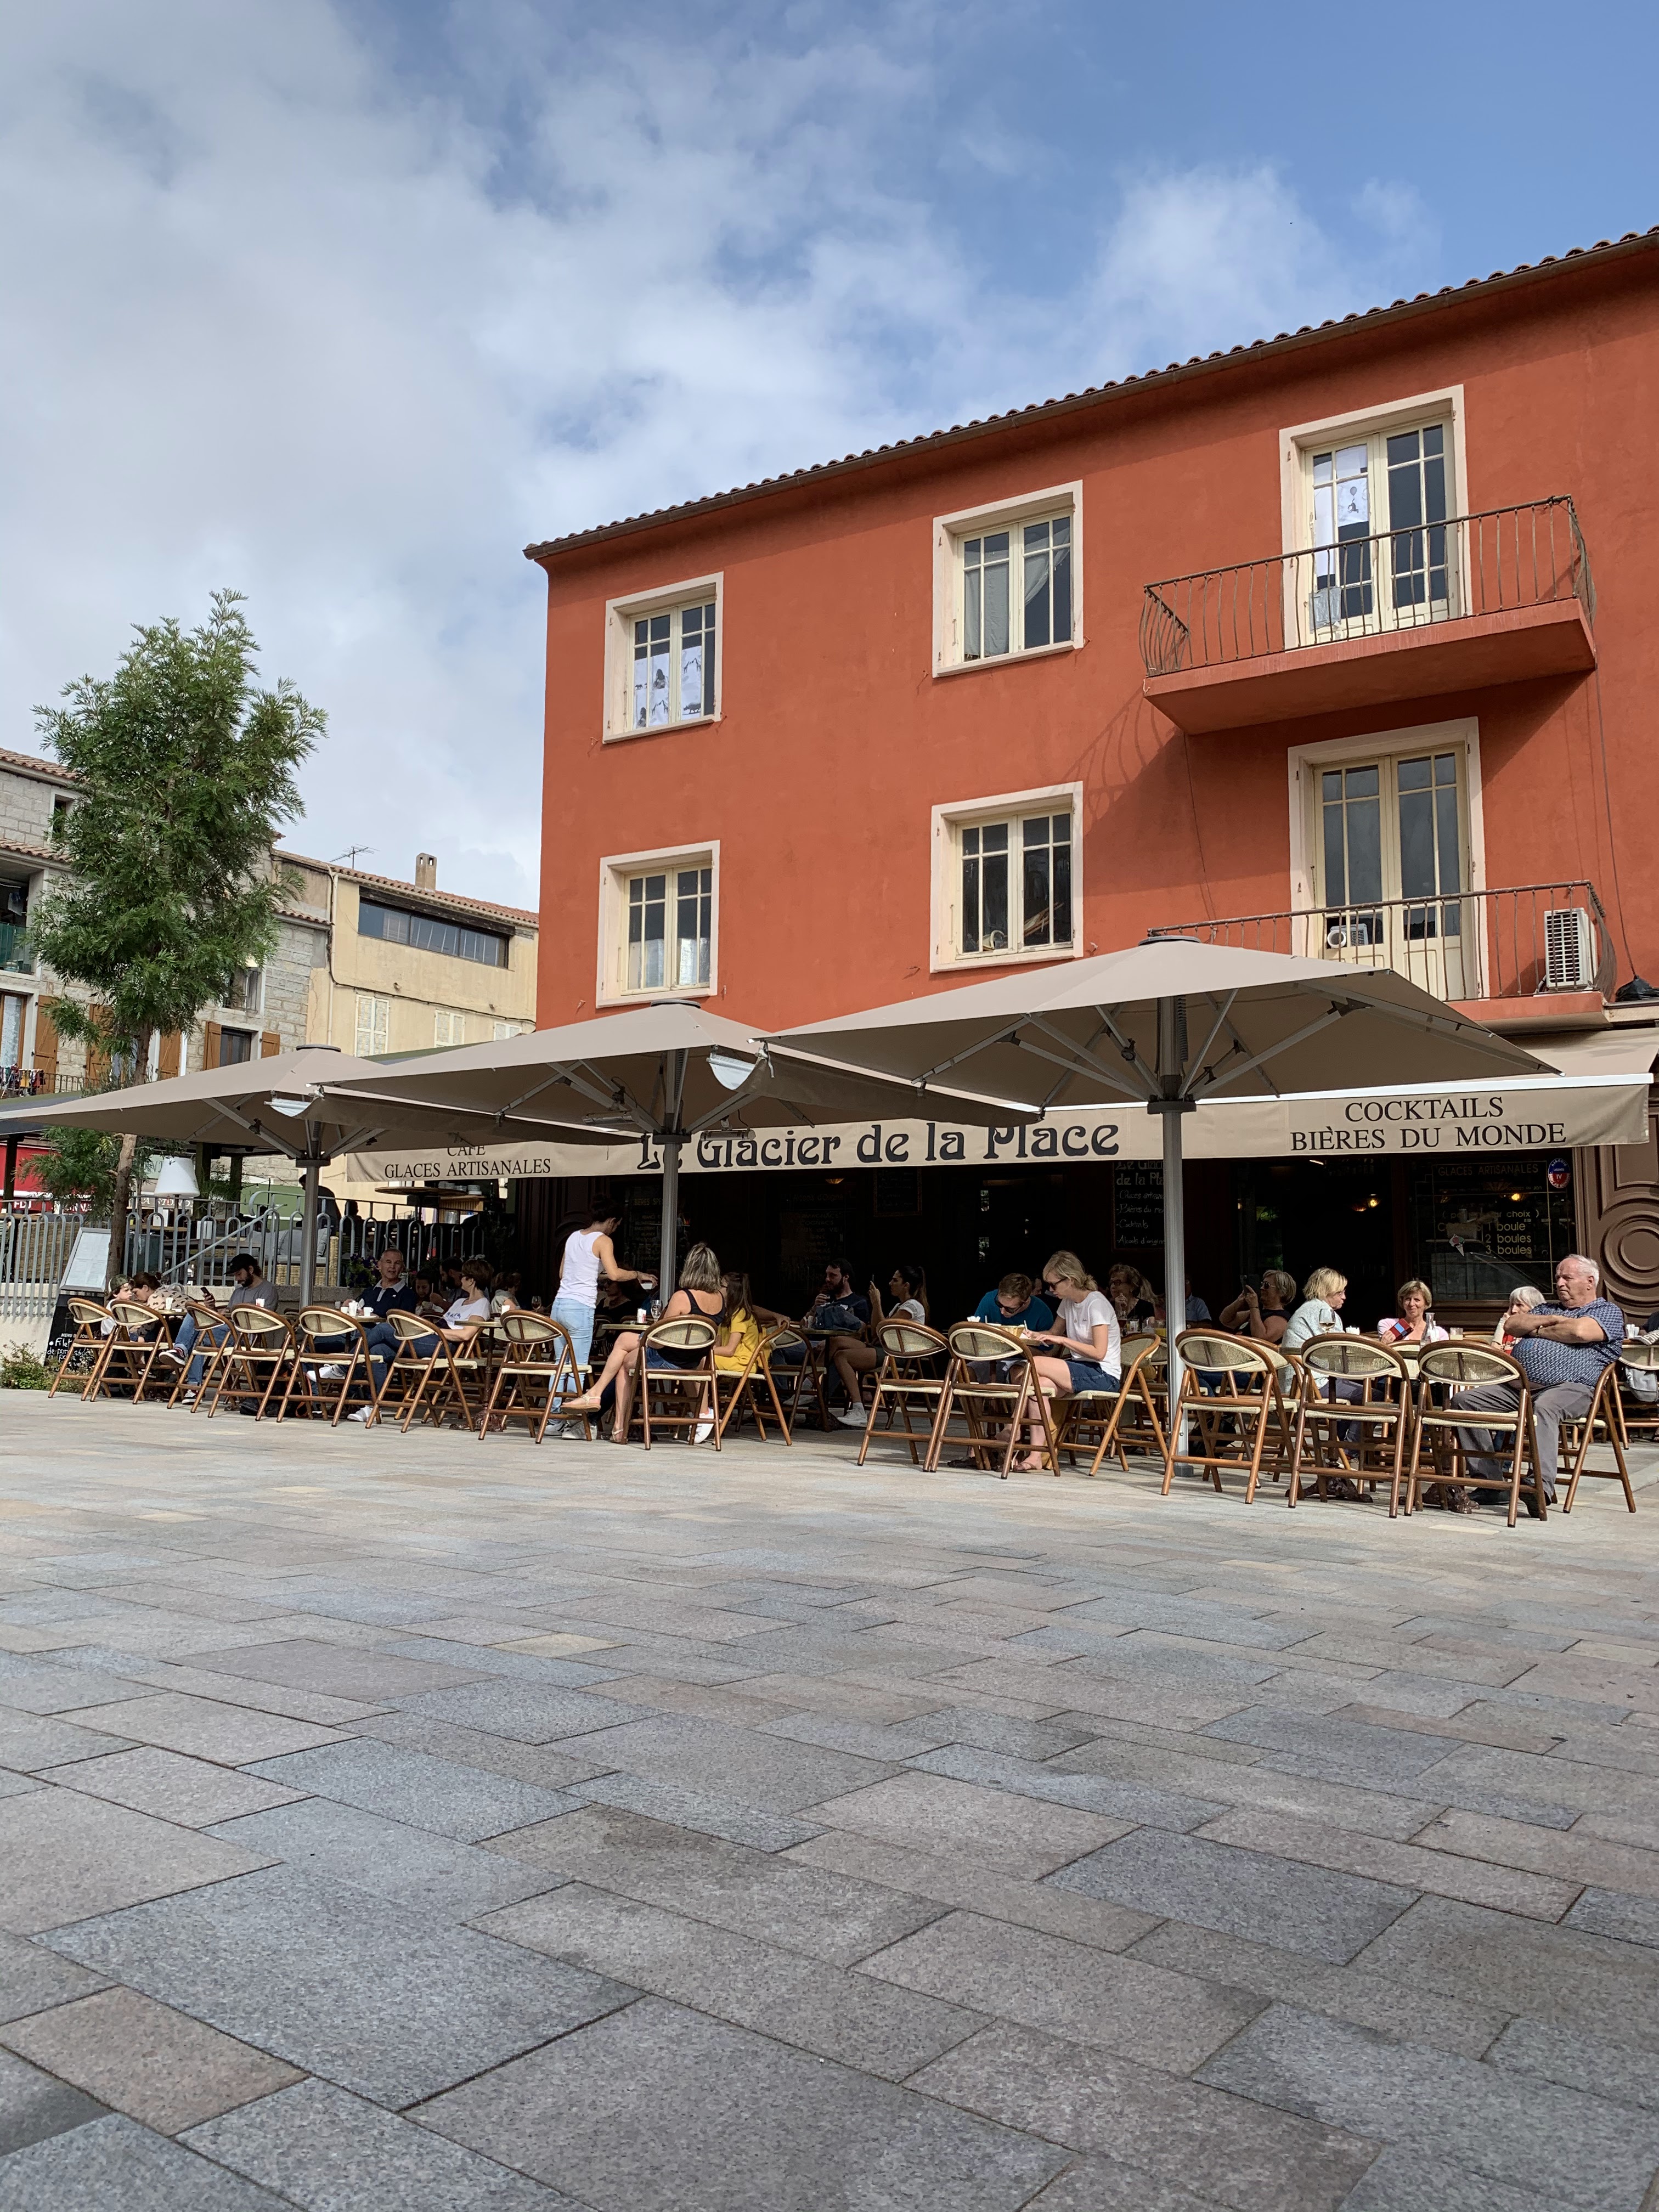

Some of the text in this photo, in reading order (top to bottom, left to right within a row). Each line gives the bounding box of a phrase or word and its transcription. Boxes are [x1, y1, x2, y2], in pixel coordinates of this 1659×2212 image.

[1345, 1097, 1503, 1122] COCKTAILS
[1290, 1122, 1567, 1151] BIÈRES DU MONDE
[697, 1130, 840, 1169] Glacier
[857, 1125, 909, 1163] de
[925, 1122, 966, 1161] la
[983, 1125, 1119, 1160] Place
[385, 1159, 551, 1178] GLACES ARTISANALES
[1438, 1164, 1539, 1176] GLACES ARTISANALES
[1116, 1173, 1132, 1186] de
[1135, 1172, 1146, 1186] la
[1506, 1210, 1531, 1218] choix
[1497, 1221, 1526, 1231] boule
[1485, 1233, 1532, 1244] 2 boules
[1485, 1245, 1532, 1255] 3 boules
[55, 1337, 72, 1348] Filet
